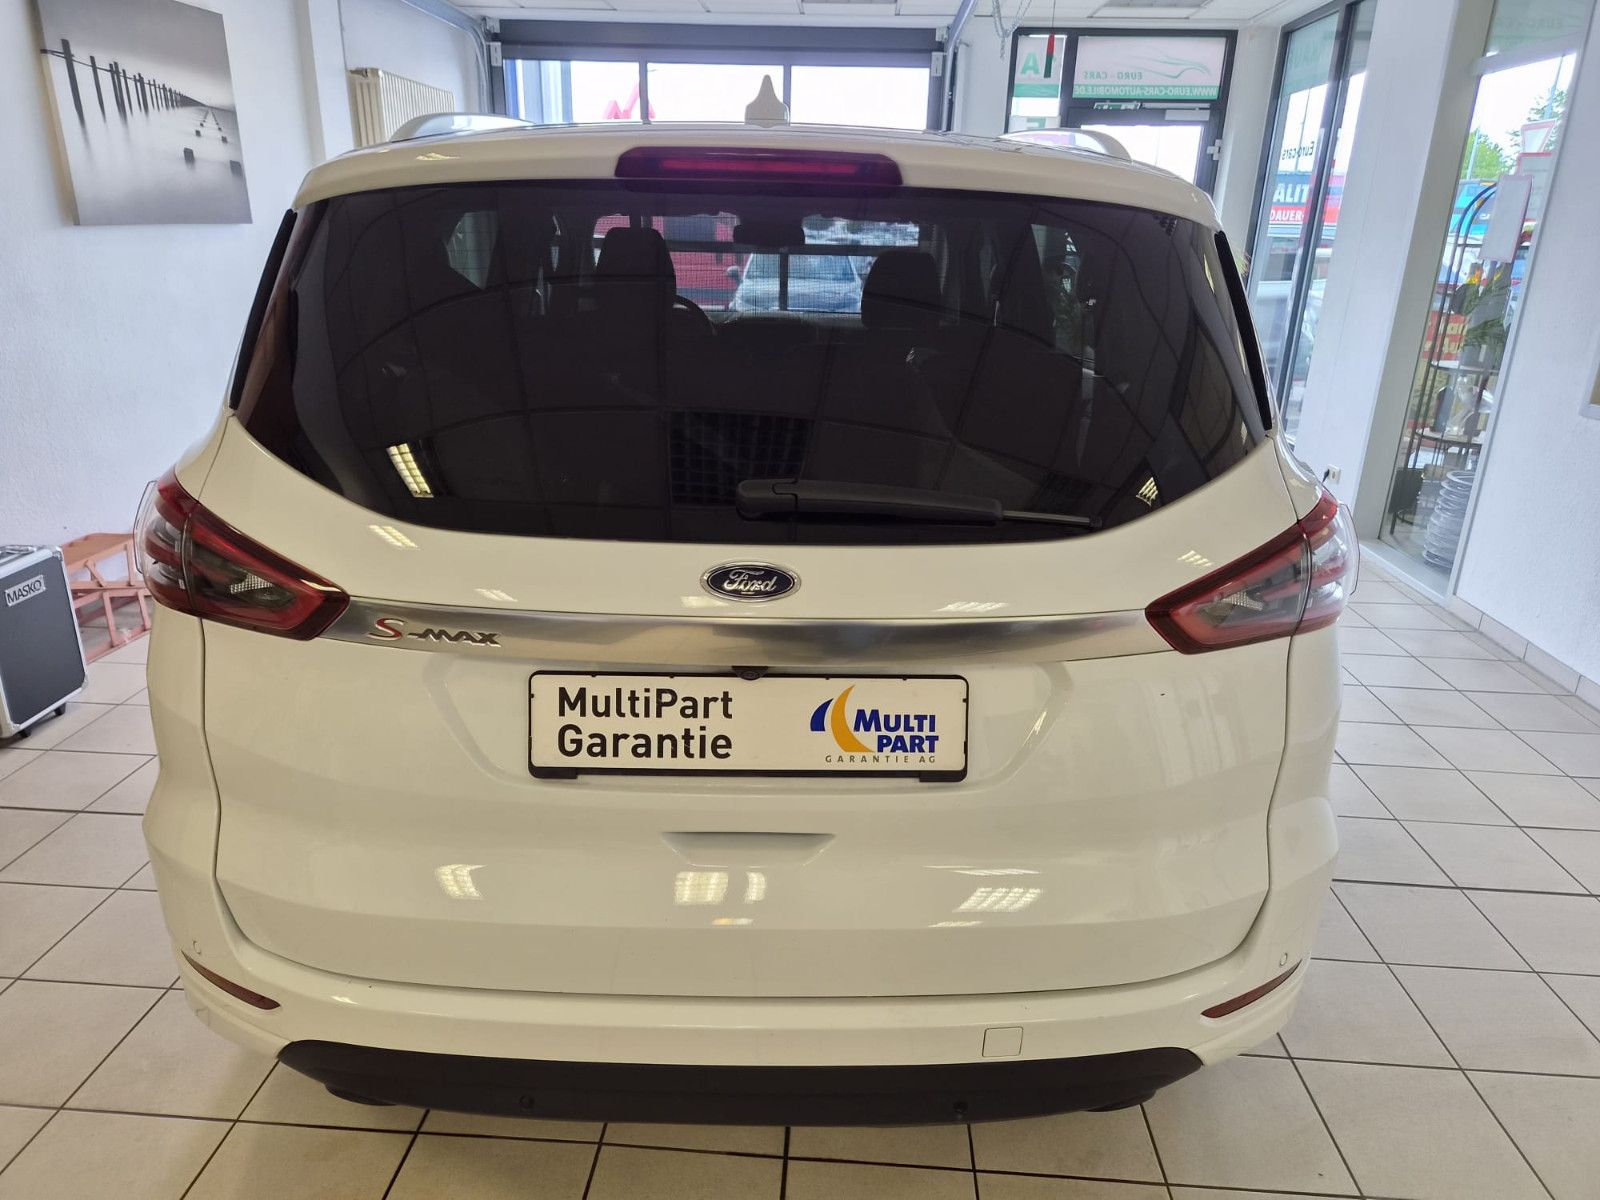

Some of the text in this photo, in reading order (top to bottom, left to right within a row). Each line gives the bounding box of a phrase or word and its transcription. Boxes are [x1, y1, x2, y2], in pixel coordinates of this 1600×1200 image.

[6, 579, 42, 604] MASKO
[723, 569, 777, 591] Ford
[367, 618, 501, 647] S-MAX
[558, 687, 733, 719] MultiPart
[854, 708, 936, 732] MULTI
[558, 724, 733, 759] Garantie
[877, 734, 940, 753] PART
[825, 755, 936, 764] GARANTIE AG
